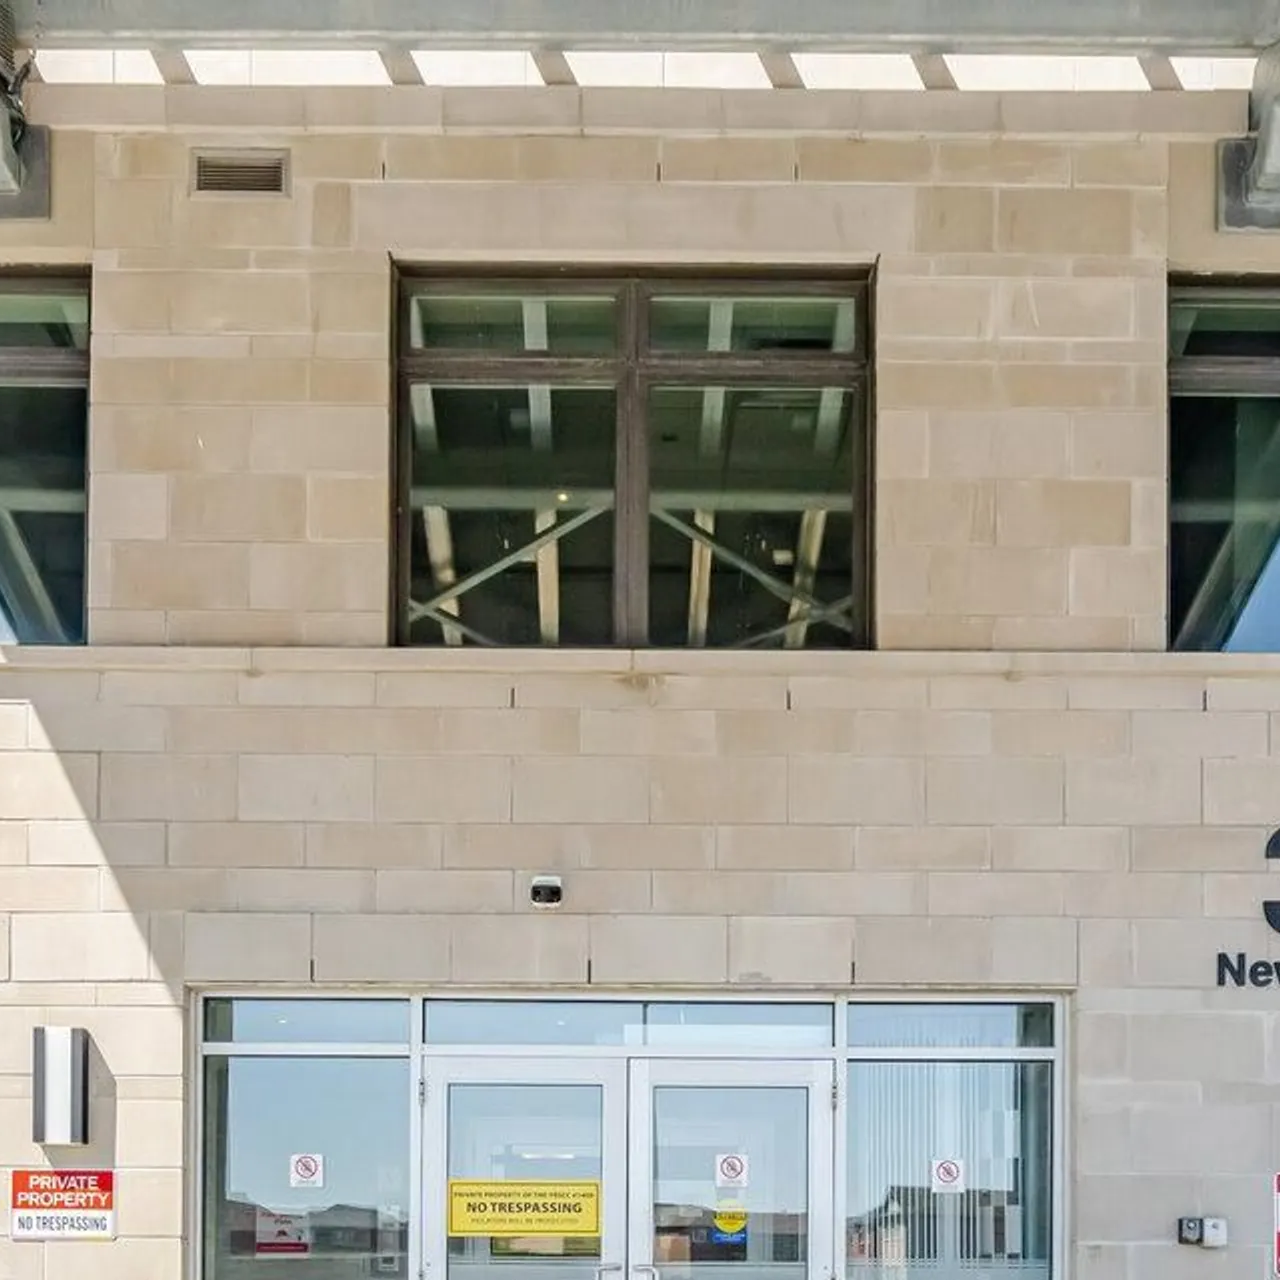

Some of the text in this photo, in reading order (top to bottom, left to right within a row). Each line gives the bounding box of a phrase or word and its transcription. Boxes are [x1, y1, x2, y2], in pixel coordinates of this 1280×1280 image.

[29, 1175, 99, 1190] PRIVATE
[16, 1192, 111, 1207] PROPERTY
[466, 1202, 583, 1213] NO TRESPASSING
[17, 1215, 108, 1231] NO TRESPASSING
